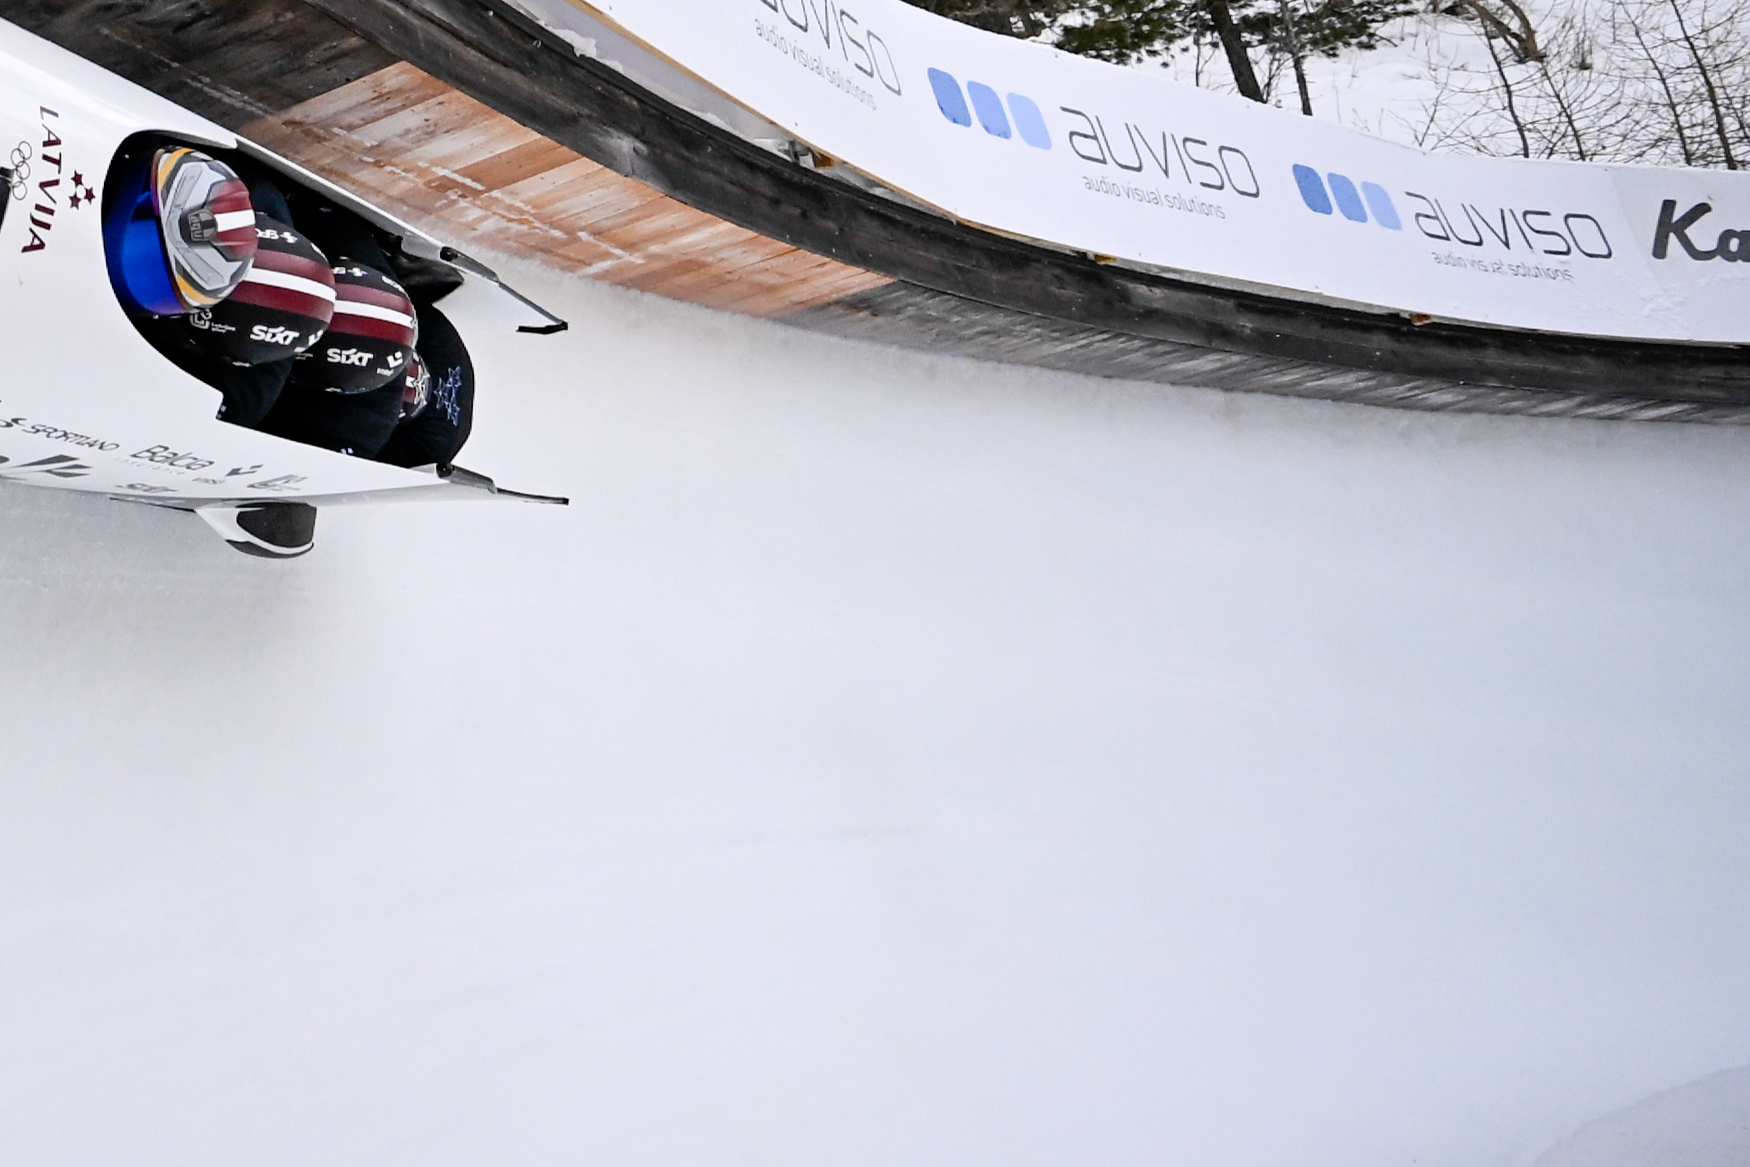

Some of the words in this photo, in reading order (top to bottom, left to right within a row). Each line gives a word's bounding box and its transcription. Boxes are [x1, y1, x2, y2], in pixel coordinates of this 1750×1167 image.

[754, 18, 789, 55] audio
[788, 39, 826, 78] visual
[825, 66, 877, 110] solutions
[21, 104, 61, 254] LATVIJA
[1060, 105, 1260, 198] auviso
[1082, 175, 1121, 198] audio
[1122, 181, 1164, 206] visual
[1164, 192, 1226, 220] solutions
[1404, 191, 1612, 259] auviso
[130, 444, 215, 471] Balcia
